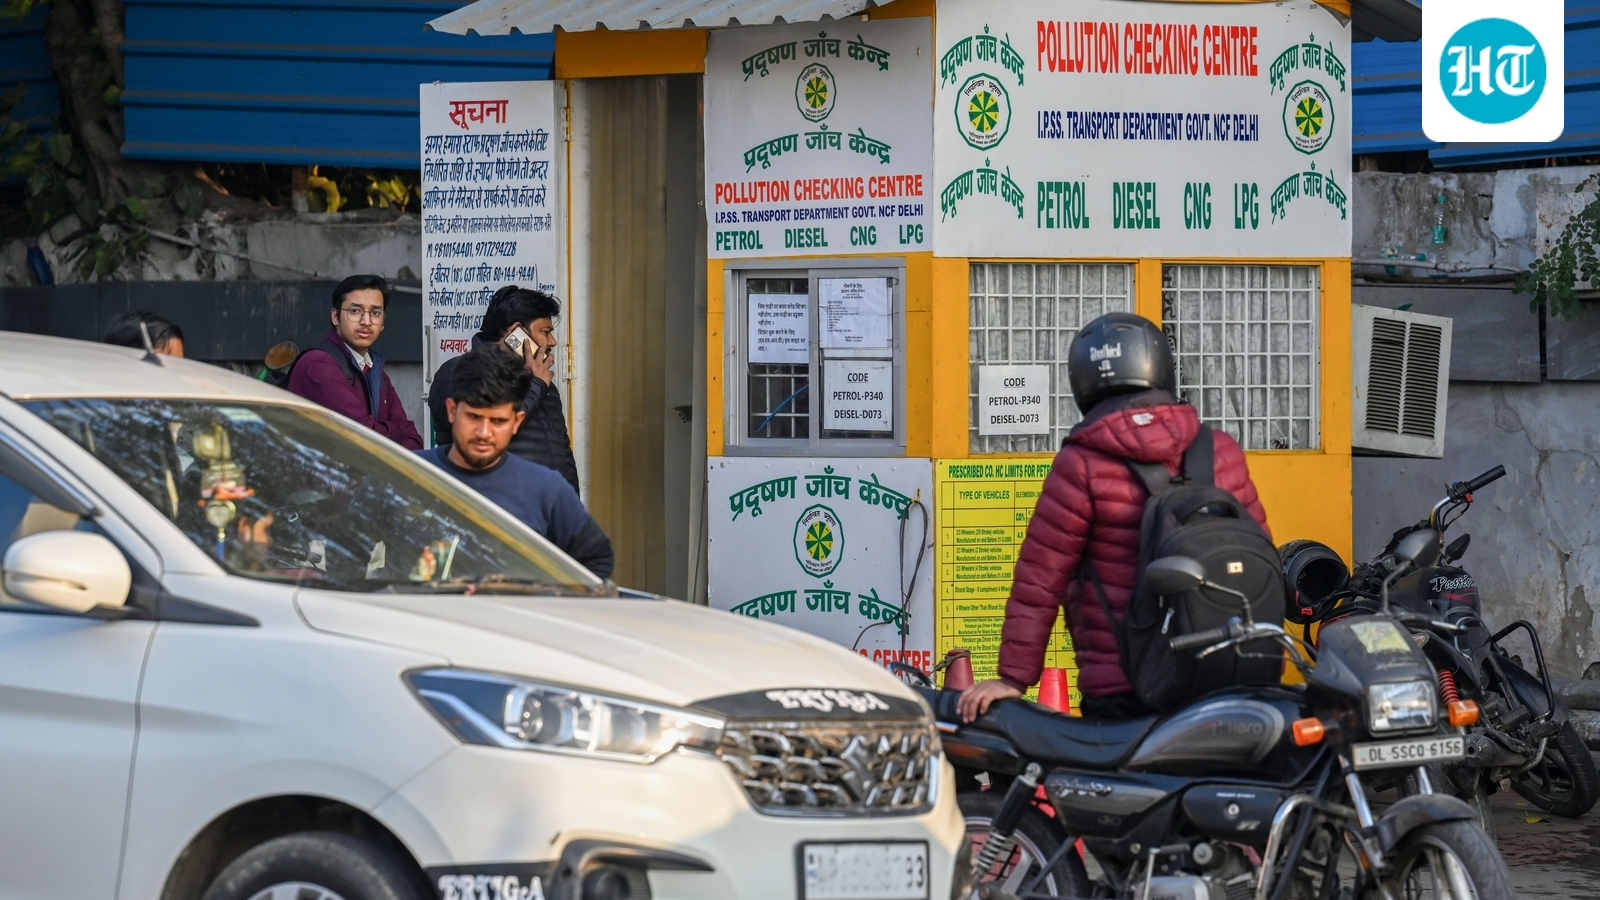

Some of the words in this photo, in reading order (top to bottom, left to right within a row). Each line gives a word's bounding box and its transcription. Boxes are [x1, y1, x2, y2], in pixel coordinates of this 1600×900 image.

[741, 42, 797, 82] प्रदूषण
[803, 30, 841, 58] जाँच
[847, 34, 890, 71] केन्द्र
[941, 36, 972, 90] प्रदूषण
[976, 23, 997, 63] जाँच
[1000, 32, 1024, 86] केन्द्र
[1037, 20, 1119, 74] POLLUTION
[1124, 22, 1198, 75] CHECKING
[1203, 25, 1258, 76] CENTRE
[1270, 44, 1299, 96] प्रदूषण
[1302, 32, 1321, 70] जाँच
[1324, 41, 1346, 93] केन्द्र
[449, 100, 509, 130] सूचना
[1037, 110, 1064, 139] I.P.SS.
[1067, 111, 1120, 140] TRANSPORT
[1123, 112, 1183, 141] DEPARTMENT
[1186, 113, 1211, 141] GOVT.
[1214, 113, 1230, 141] NCF
[1233, 114, 1259, 141] DELHI
[425, 135, 443, 154] अगर
[443, 134, 463, 154] हमारा
[463, 134, 480, 154] स्टाफ
[480, 134, 501, 157] प्रदूषण
[744, 134, 798, 174] प्रदूषण
[804, 123, 842, 150] जाँच
[848, 127, 891, 164] केन्द्र
[423, 158, 449, 182] निर्धारित
[450, 157, 466, 182] राशि
[465, 158, 474, 181] से
[496, 157, 506, 180] पैसे
[520, 156, 530, 180] तो
[529, 160, 549, 181] अन्दर
[475, 186, 483, 208] से
[511, 188, 519, 207] या
[715, 180, 789, 204] POLLUTION
[794, 177, 864, 201] CHECKING
[868, 174, 923, 198] CENTRE
[941, 170, 973, 223] प्रदूषण
[976, 157, 998, 196] जाँच
[1001, 165, 1024, 219] केन्द्र
[1271, 173, 1299, 225] प्रदूषण
[1303, 160, 1322, 198] जाँच
[1325, 169, 1347, 220] केन्द्र
[742, 209, 791, 222] TRANSPORT
[794, 207, 849, 220] DEPARTMENT
[852, 206, 876, 218] GOVT.
[879, 205, 895, 217] NCF
[898, 204, 923, 216] DELHI
[1037, 181, 1089, 229] PETROL
[1113, 181, 1160, 230] DIESEL
[1184, 182, 1211, 230] CNG
[1234, 182, 1259, 230] LPG
[716, 230, 763, 250] PETROL
[785, 228, 828, 248] DIESEL
[850, 226, 876, 246] CNG
[899, 224, 923, 244] LPG
[475, 241, 517, 257] 9717294228
[464, 267, 476, 282] GST
[476, 262, 492, 282] सहित
[465, 290, 477, 306] GST
[440, 339, 469, 353] धन्यवाद
[847, 373, 868, 382] CODE
[1004, 377, 1025, 387] CODE
[833, 391, 883, 401] PETROL-P340
[989, 395, 1040, 406] PETROL-P340
[834, 409, 882, 419] DEISEL-D073
[991, 414, 1039, 424] DEISEL-D073
[949, 465, 984, 478] PRESCRIBED
[996, 465, 1003, 477] HC
[1005, 465, 1023, 477] LIMITS
[1024, 465, 1035, 477] FOR
[729, 475, 797, 522] प्रदूषण
[804, 464, 851, 500] जाँच
[959, 491, 973, 499] TYPE
[975, 491, 982, 499] OF
[983, 490, 1010, 499] VEHICLES
[804, 579, 851, 614] जाँच
[1369, 748, 1385, 761] DL
[1430, 741, 1460, 756] 6156
